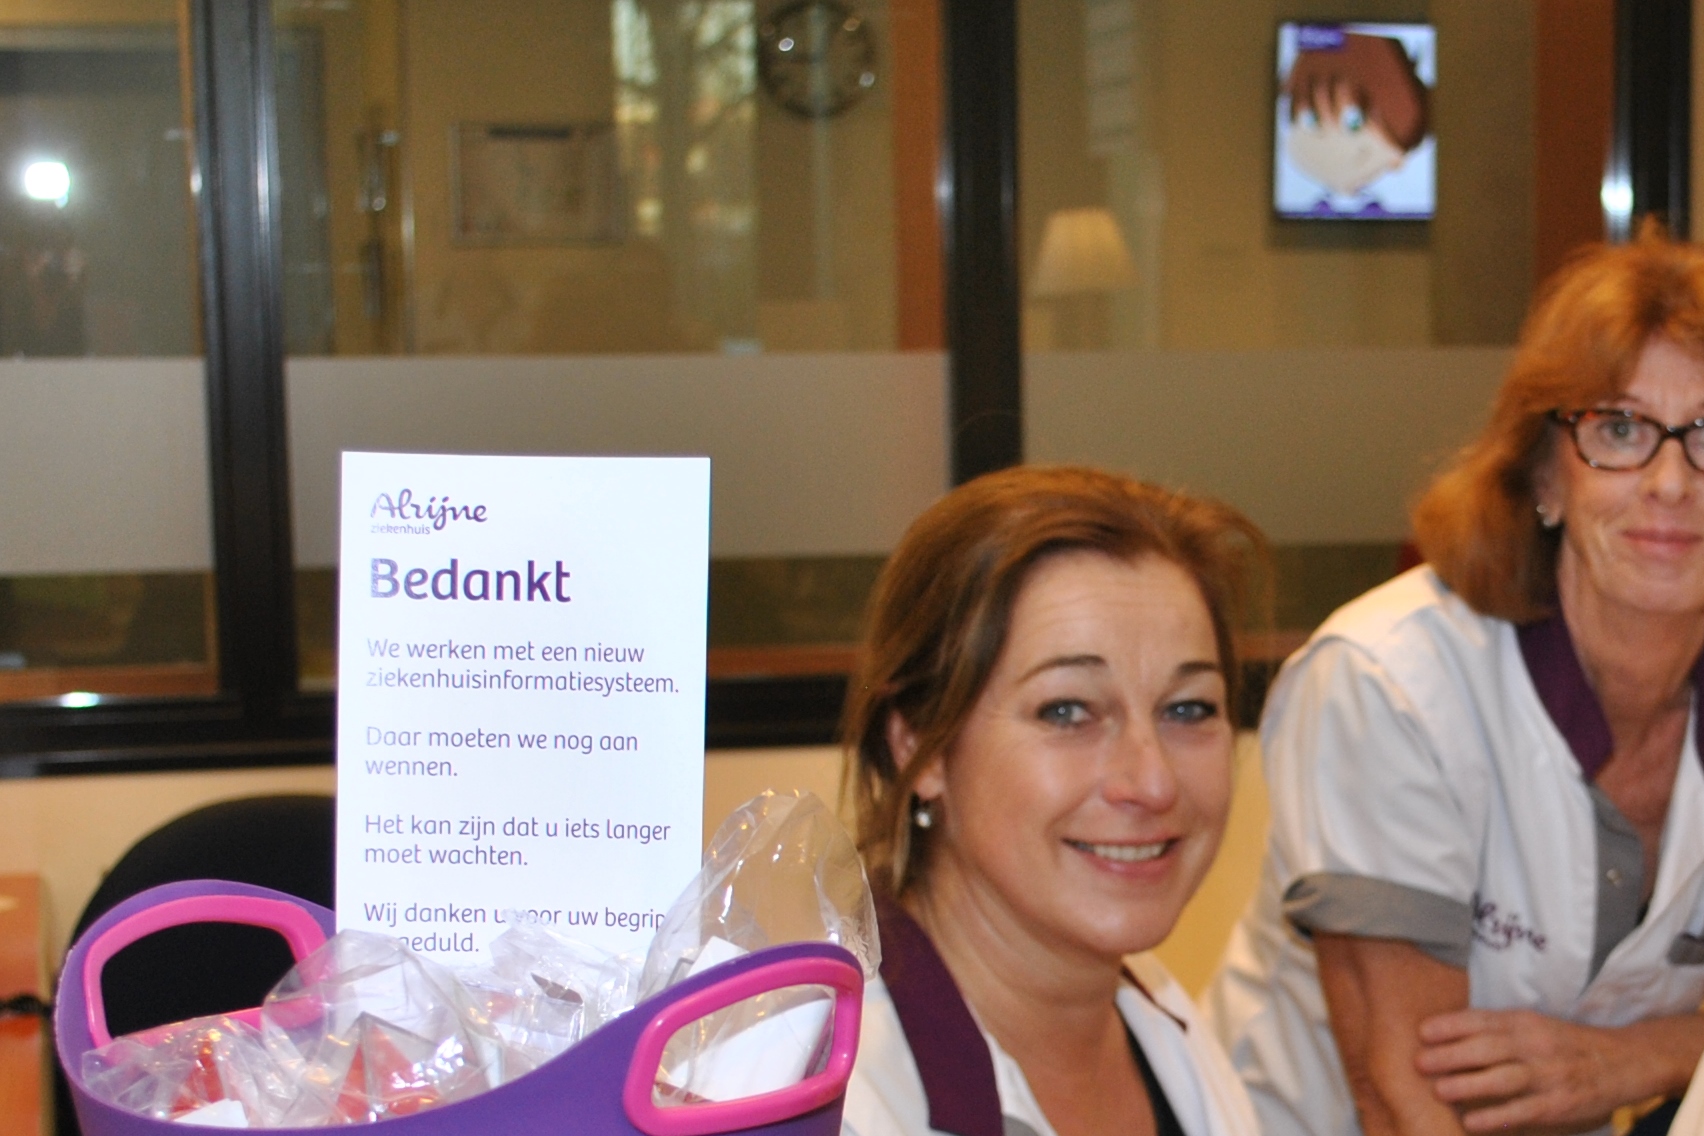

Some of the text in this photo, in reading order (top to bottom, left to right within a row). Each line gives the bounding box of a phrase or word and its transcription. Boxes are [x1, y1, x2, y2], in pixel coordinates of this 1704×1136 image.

[369, 487, 489, 532] Alrijne
[370, 523, 431, 536] ziekenhuis
[369, 557, 572, 603] Bedankt
[367, 638, 645, 663] We werken met een nieuw
[366, 667, 680, 697] ziekenhuisinformatiesysteem.
[366, 726, 639, 755] Daar moeten we nog aan
[365, 756, 459, 778] wennen.
[364, 814, 671, 844] Het kan zijn dat u iets langer
[364, 844, 529, 866] moet wachten.
[363, 902, 398, 928] Wij
[404, 902, 487, 924] danken
[568, 909, 598, 926] uw
